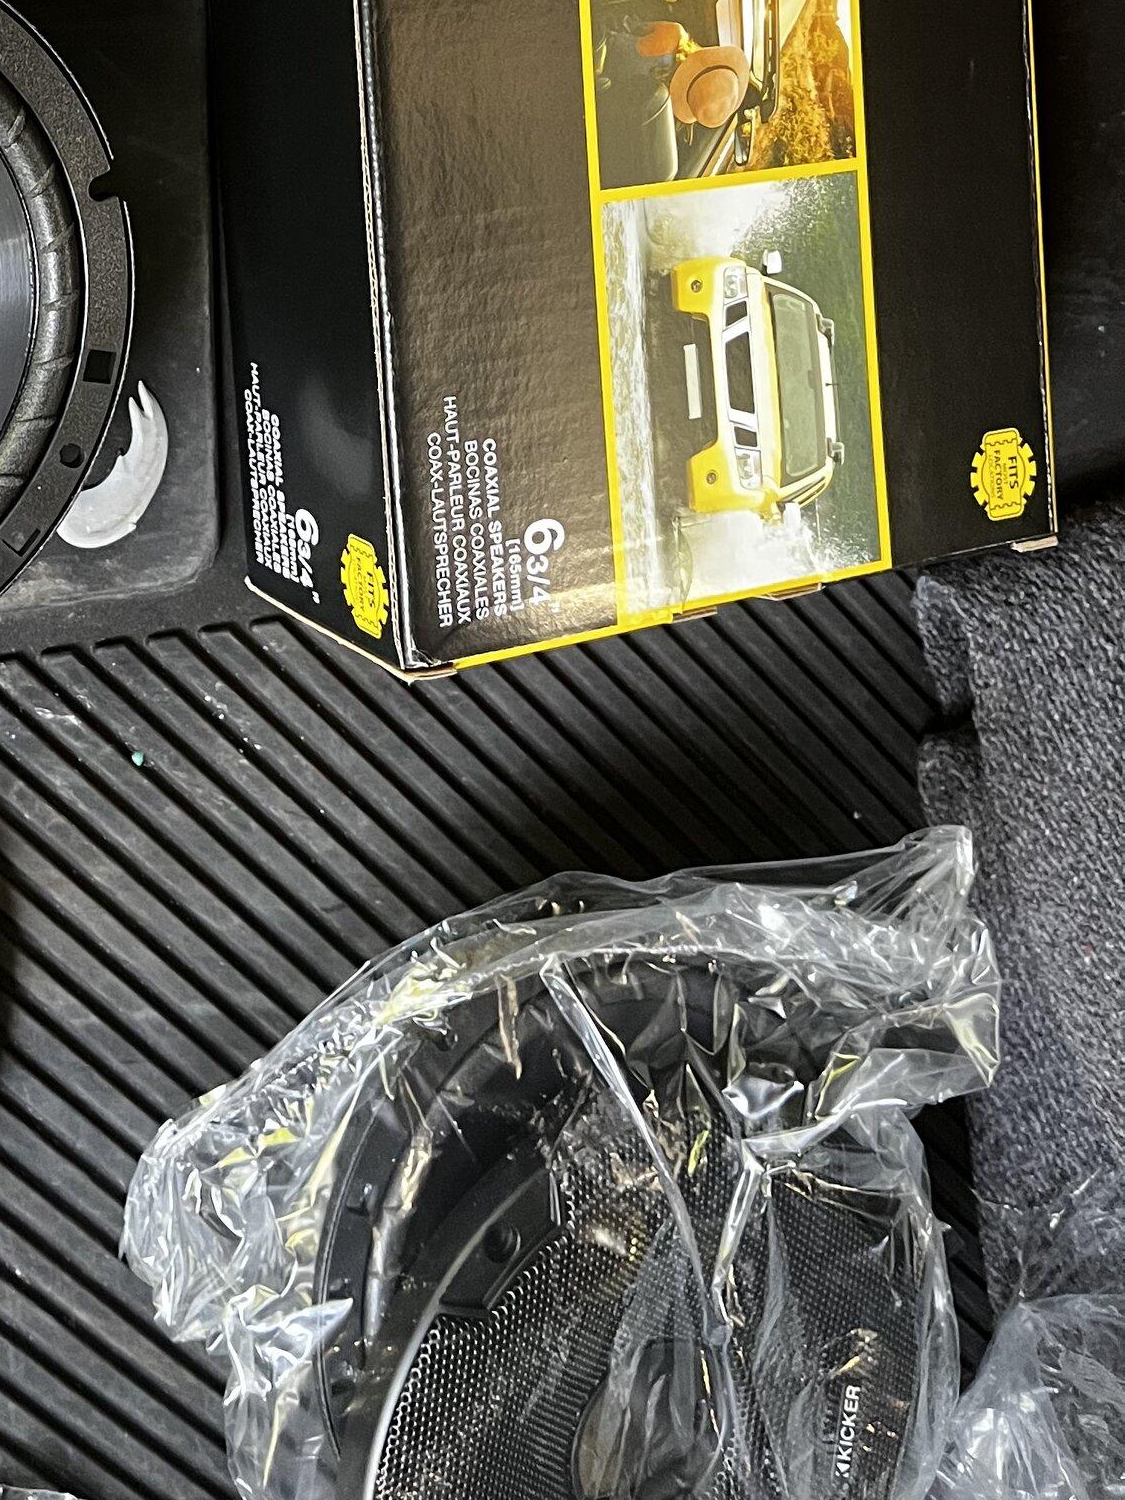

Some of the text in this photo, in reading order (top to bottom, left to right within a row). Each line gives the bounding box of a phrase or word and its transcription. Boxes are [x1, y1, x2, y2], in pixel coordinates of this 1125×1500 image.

[244, 389, 263, 564] COAX-LAUTSPRECHER
[250, 362, 273, 569] HAUT-PARLEUR COAXIAUX
[261, 408, 281, 573] BOCINAS COAXIALES
[271, 413, 290, 579] COAXIAL SPEAKERS
[427, 432, 453, 627] COAX-LAUTSPRECHER
[443, 396, 471, 624] HAUT-PARLEUR COAXIAUX
[464, 440, 490, 620] BOCINAS COAXIALES
[483, 438, 507, 616] COAXIAL SPEAKERS
[994, 449, 1003, 501] FACTORY
[1008, 456, 1019, 490] FITS
[357, 557, 365, 612] FACTORY
[367, 571, 375, 608] FITS
[506, 539, 524, 611] [165mm]
[837, 1385, 861, 1461] KICKER
